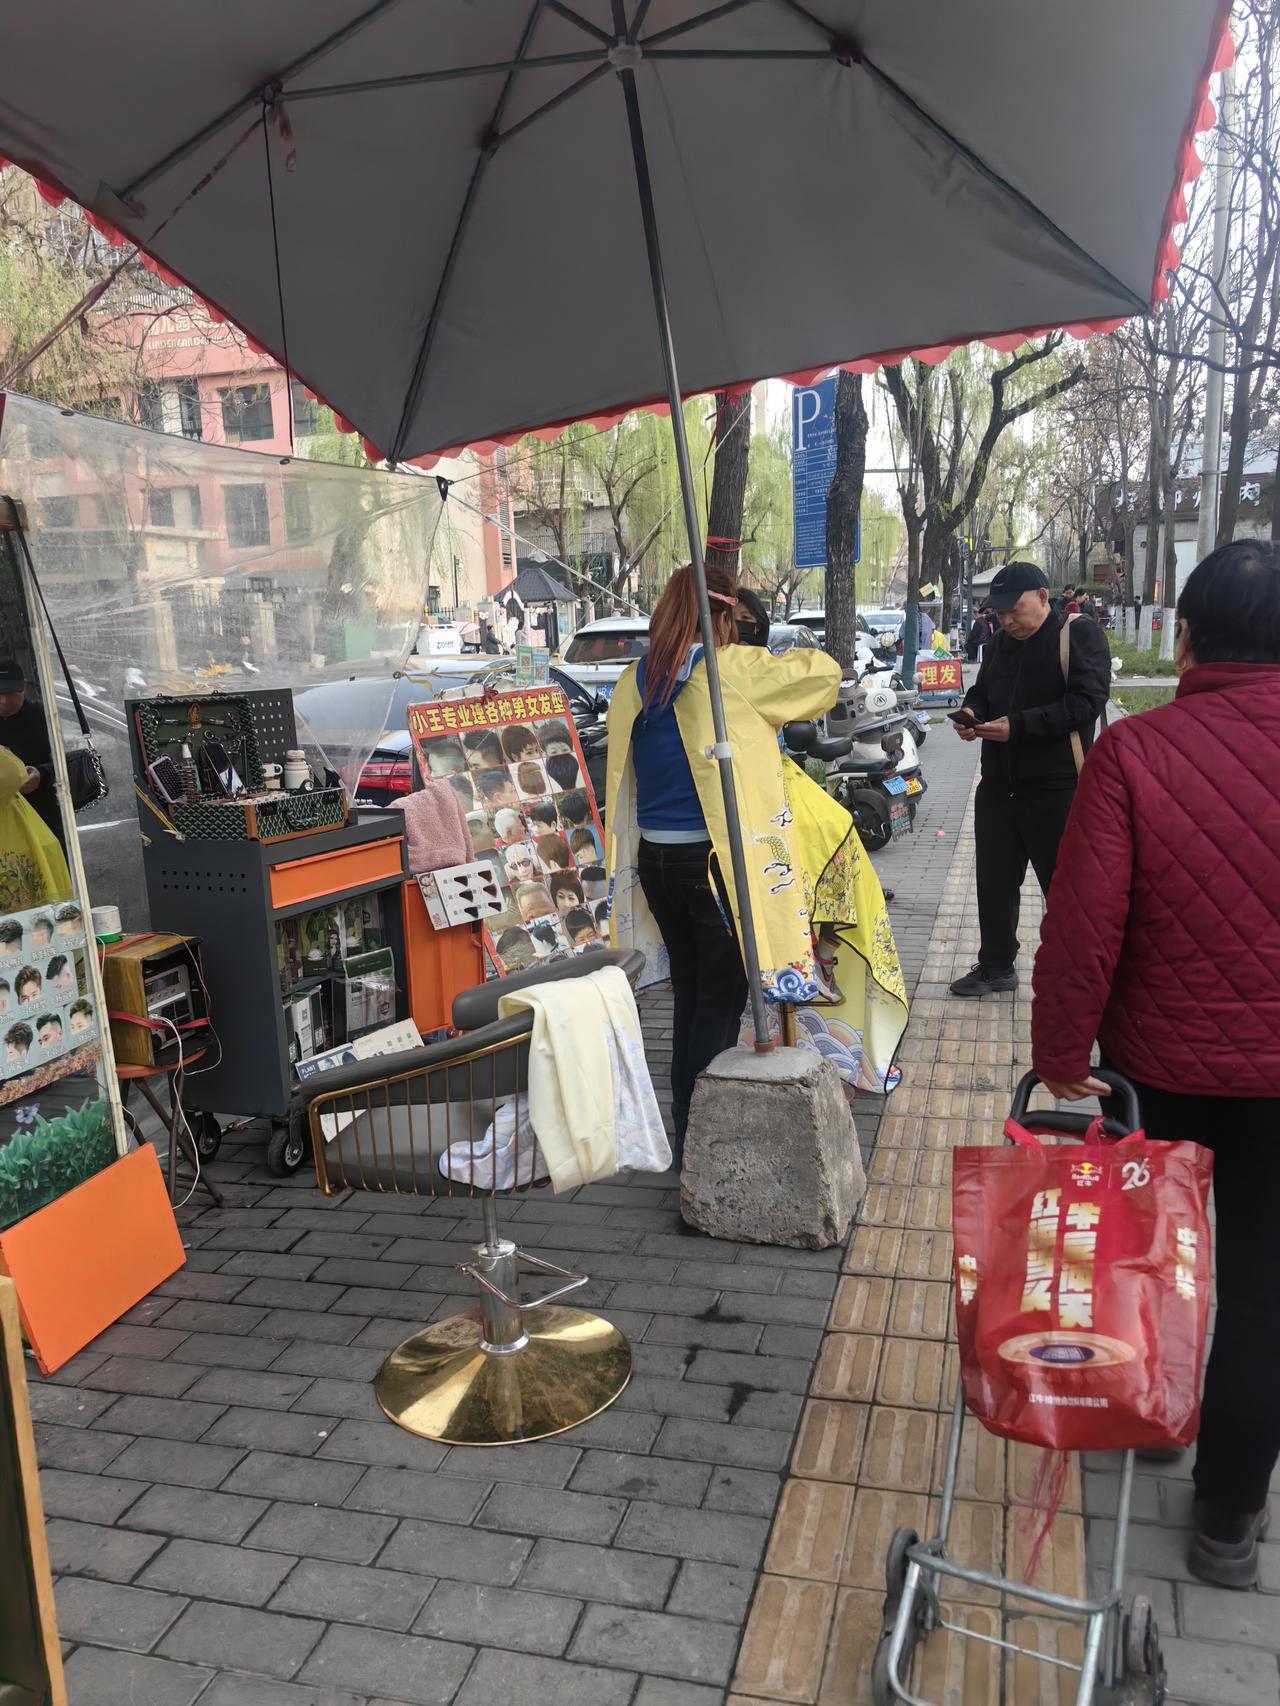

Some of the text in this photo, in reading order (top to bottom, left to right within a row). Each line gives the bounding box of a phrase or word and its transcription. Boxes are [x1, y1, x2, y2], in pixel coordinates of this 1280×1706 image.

[794, 390, 821, 452] P
[920, 664, 956, 685] 理发
[412, 692, 566, 734] 小王专业理各种男女发型
